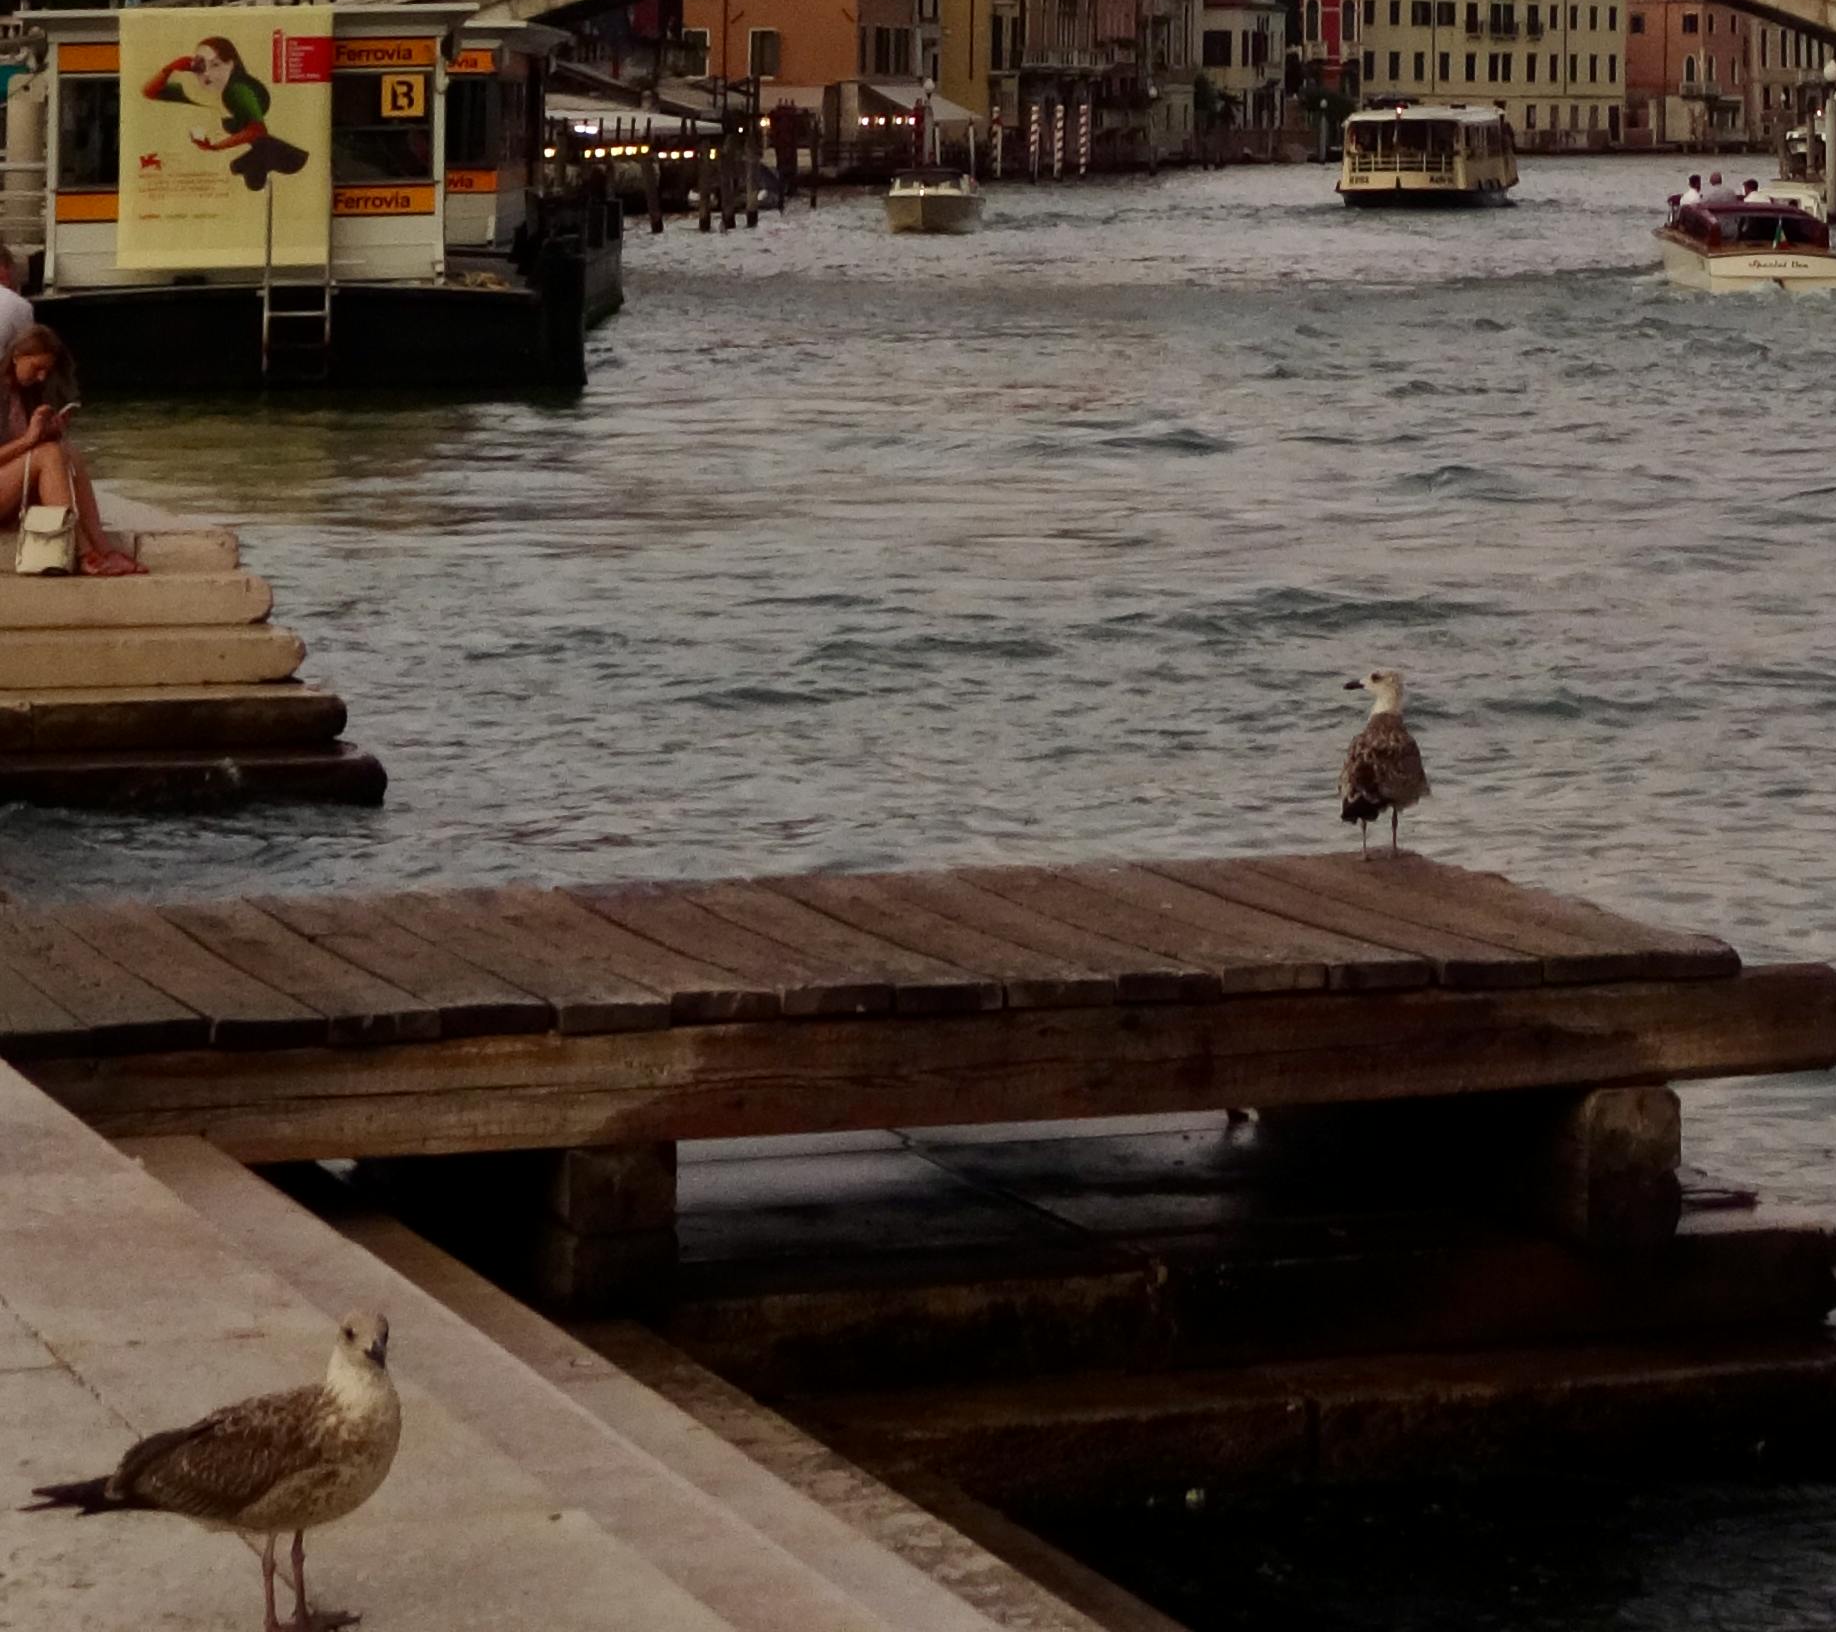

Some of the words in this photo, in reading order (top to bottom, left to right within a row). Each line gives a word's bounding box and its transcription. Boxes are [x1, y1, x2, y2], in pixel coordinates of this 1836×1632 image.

[335, 43, 413, 62] Ferrovia
[391, 80, 415, 111] B
[333, 191, 411, 211] Ferrovia
